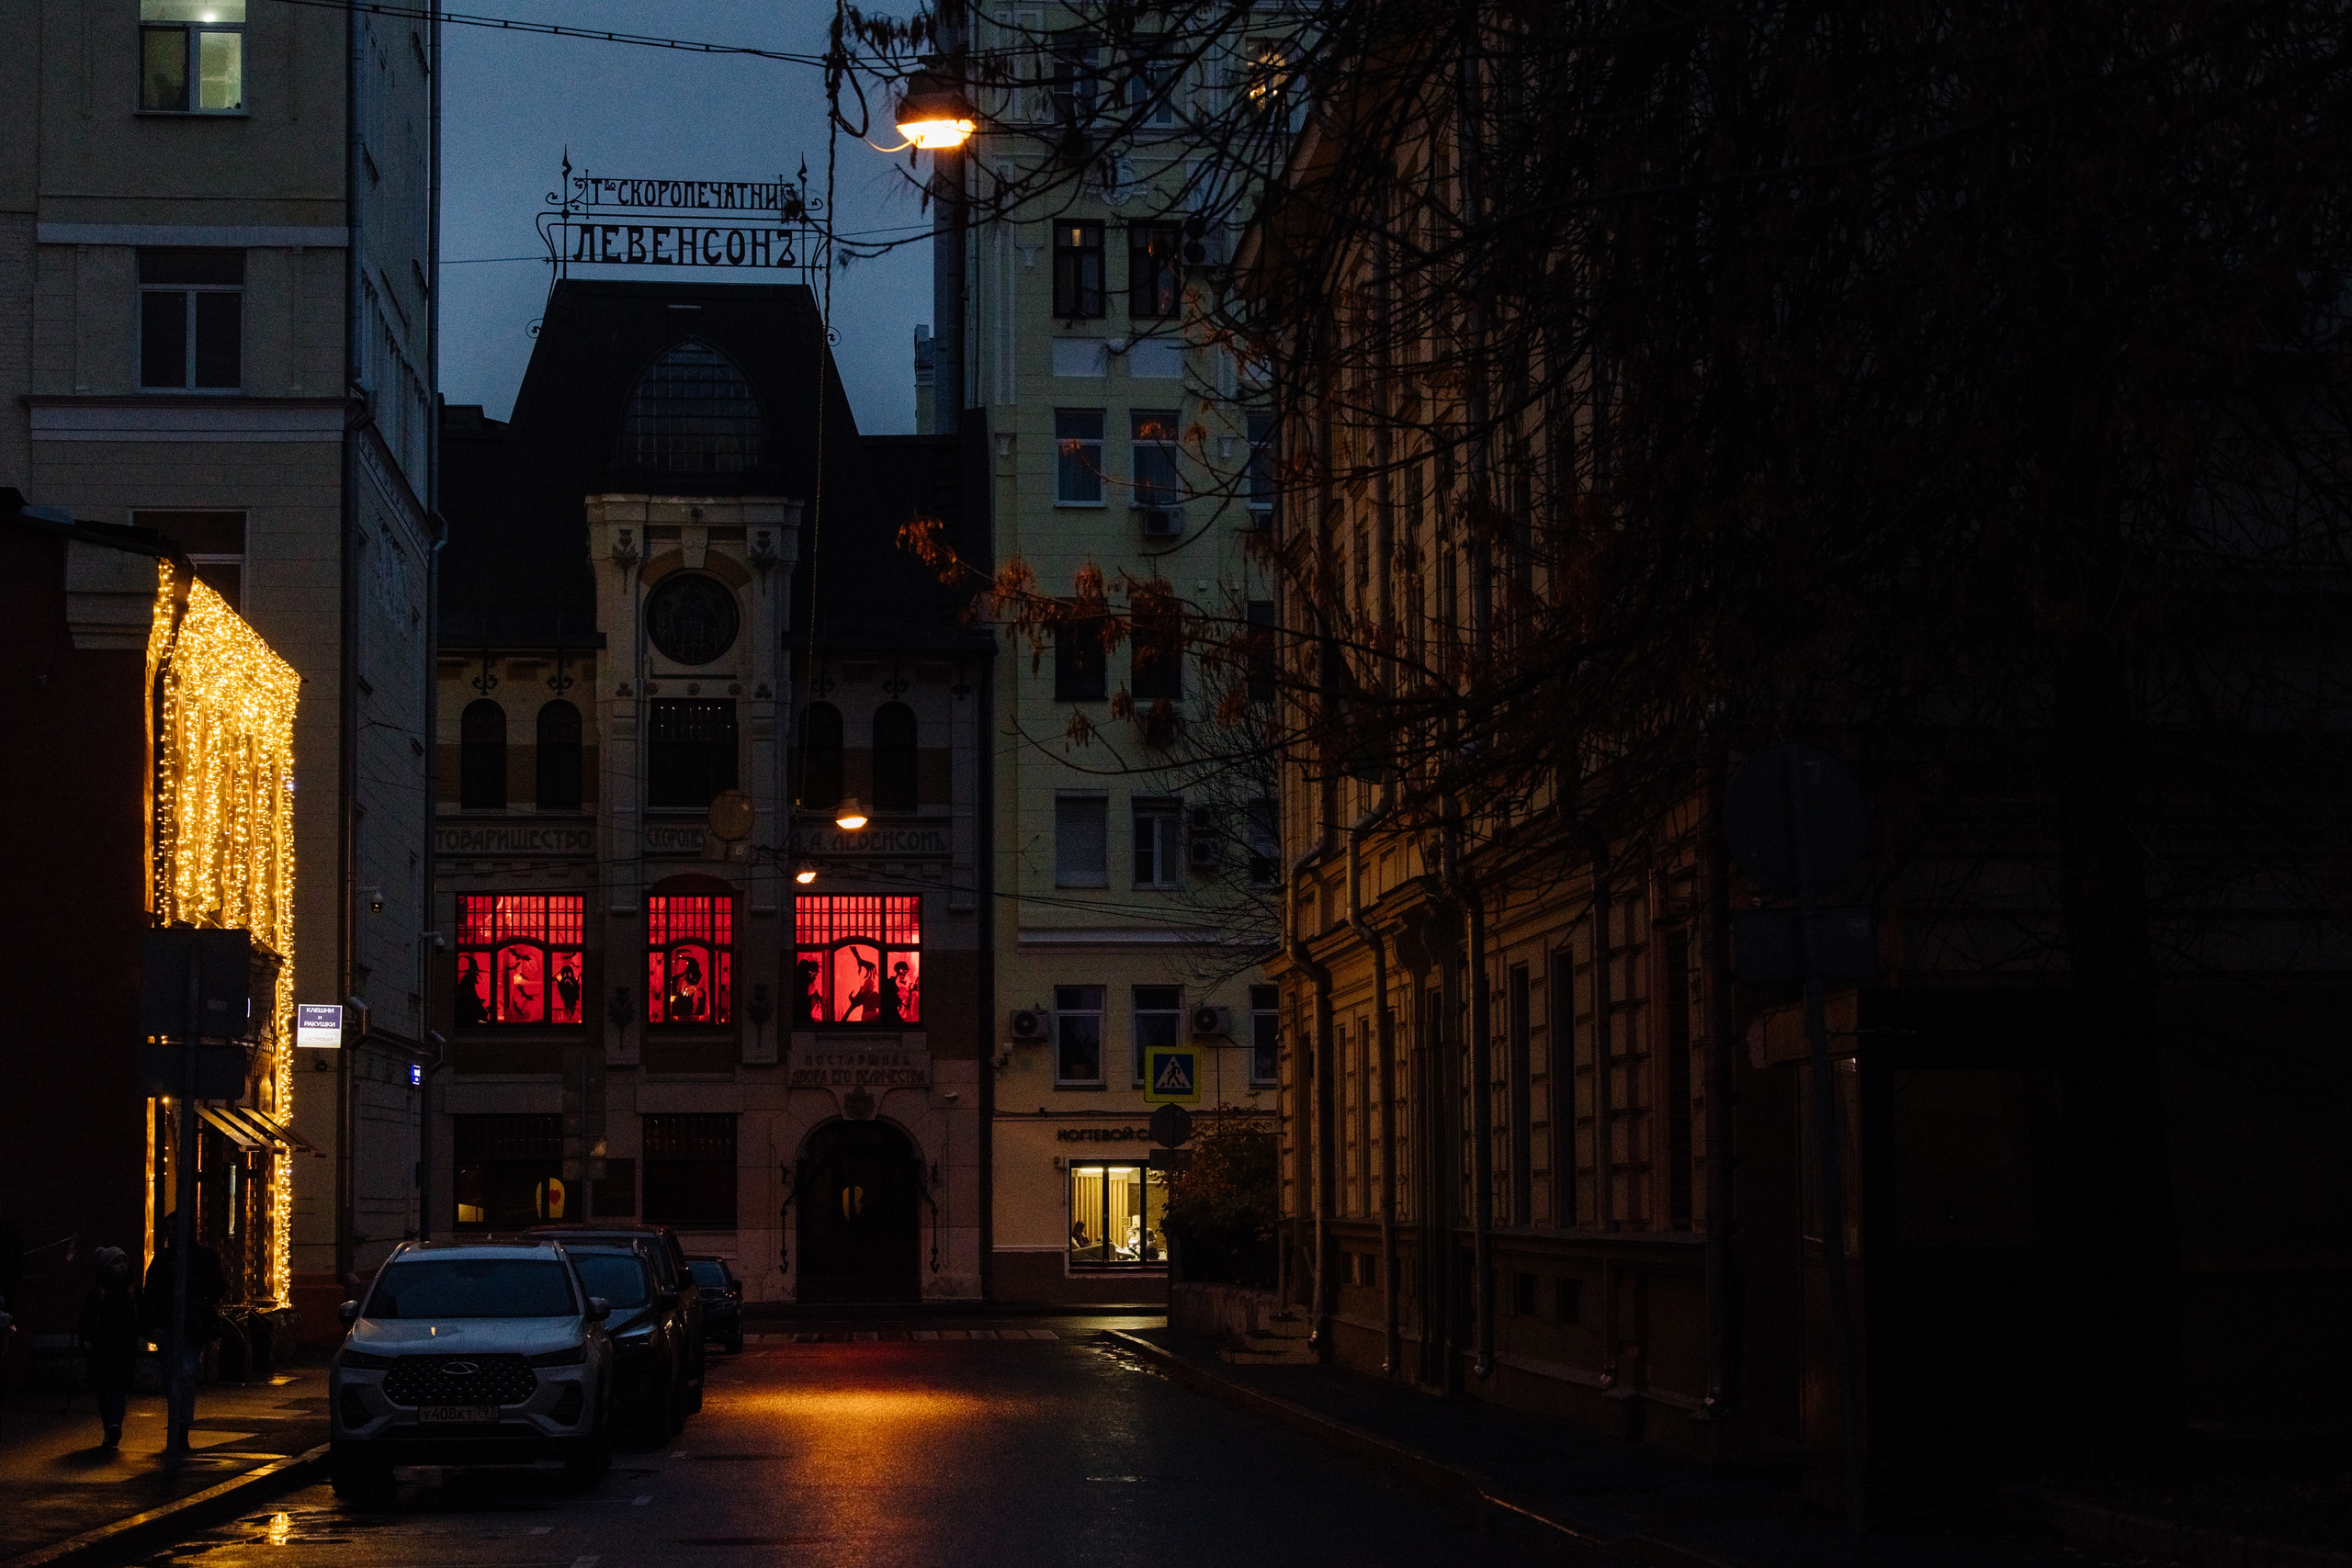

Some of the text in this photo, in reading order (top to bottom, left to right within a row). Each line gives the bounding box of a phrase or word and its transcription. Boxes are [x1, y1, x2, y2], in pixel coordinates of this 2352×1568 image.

[572, 224, 797, 267] ЛЕВЕНСОНЪ
[435, 829, 591, 850] ТОВАРИЩЕСТВО
[831, 1068, 852, 1084] ЕГО
[1057, 1127, 1133, 1141] НОГТЕВОЙ
